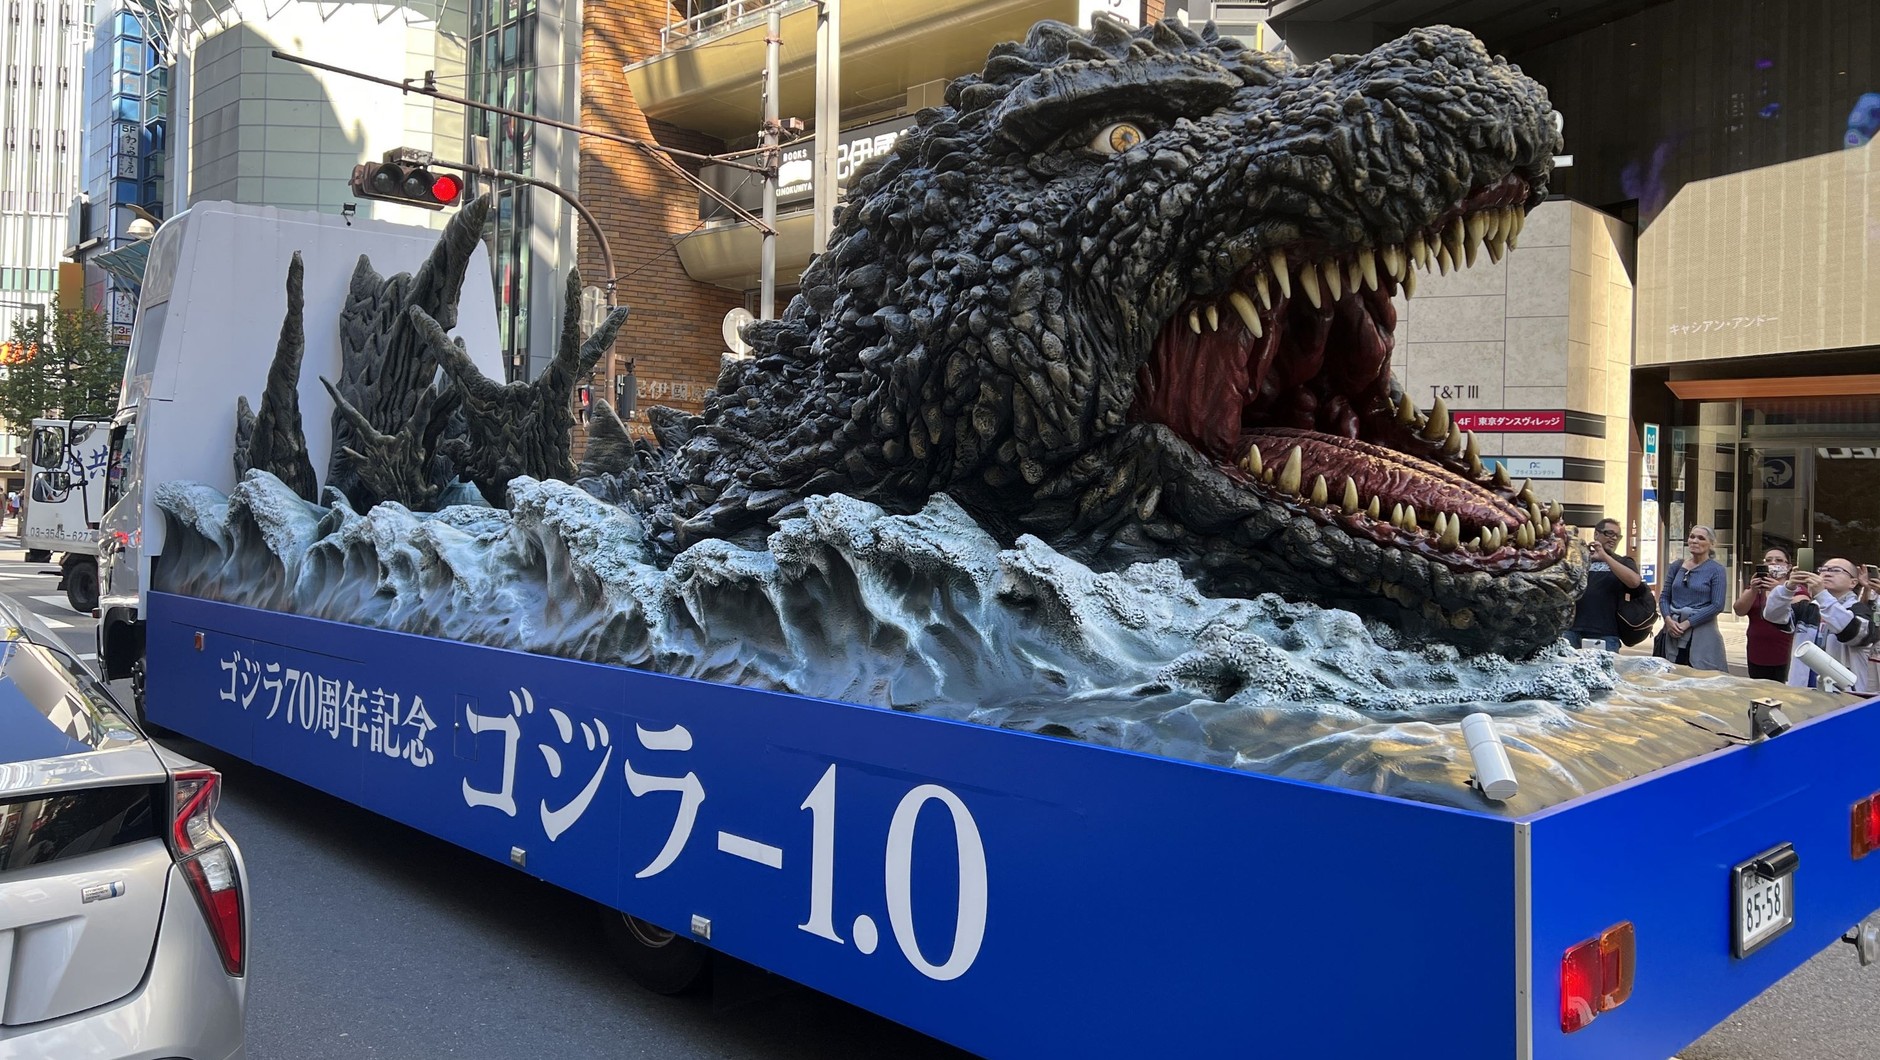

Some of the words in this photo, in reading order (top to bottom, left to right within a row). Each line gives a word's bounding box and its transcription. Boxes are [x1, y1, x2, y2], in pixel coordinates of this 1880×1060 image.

[122, 124, 136, 133] 5F
[783, 148, 807, 162] BOOKS
[119, 326, 131, 334] 3F
[1669, 314, 1779, 335] キャシアン・アンドー
[1430, 385, 1464, 399] T&T
[1457, 417, 1471, 426] 4F
[1478, 416, 1560, 426] 東京ダンスヴィレッジ
[220, 650, 437, 767] ゴジラ70周年記念
[1746, 883, 1781, 932] 85-58
